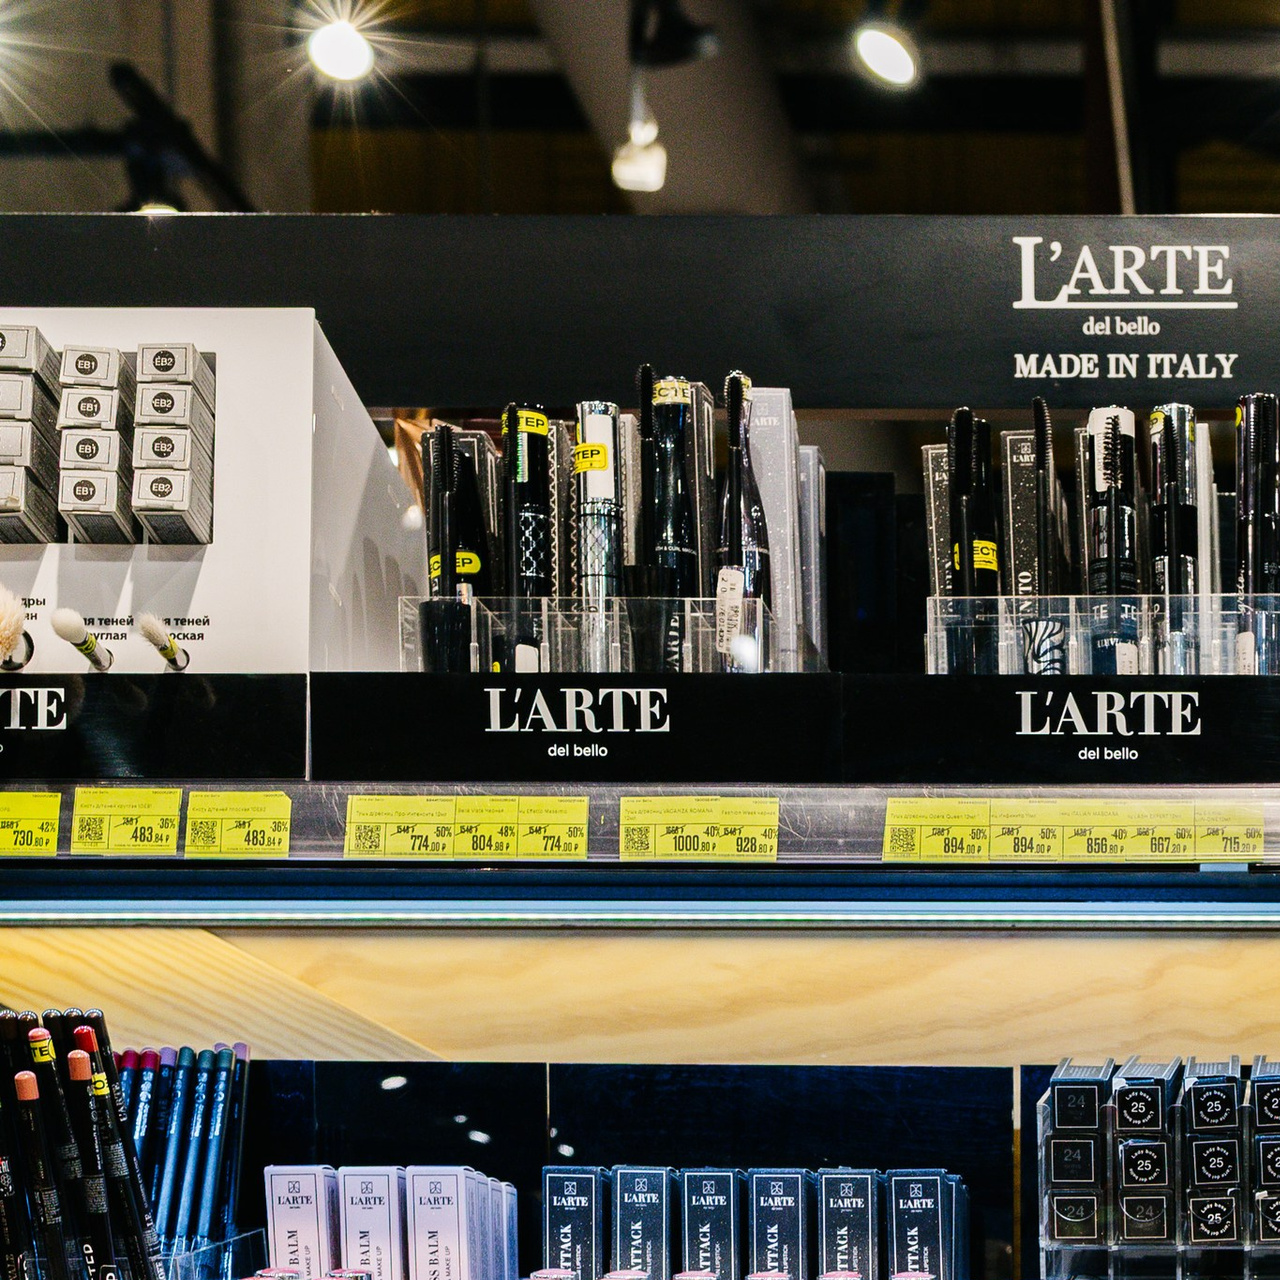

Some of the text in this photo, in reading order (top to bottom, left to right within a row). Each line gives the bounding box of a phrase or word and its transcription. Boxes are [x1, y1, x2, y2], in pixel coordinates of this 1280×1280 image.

[1012, 236, 1238, 309] L'ARTE
[1082, 316, 1160, 335] del bello
[78, 359, 95, 369] EB1
[1014, 354, 1238, 378] MADE IN ITALY
[155, 399, 172, 408] EB2
[484, 688, 670, 733] L'ARTE
[1015, 691, 1201, 736] L'ARTE
[548, 744, 608, 756] del bello
[1131, 1102, 1145, 1113] 25
